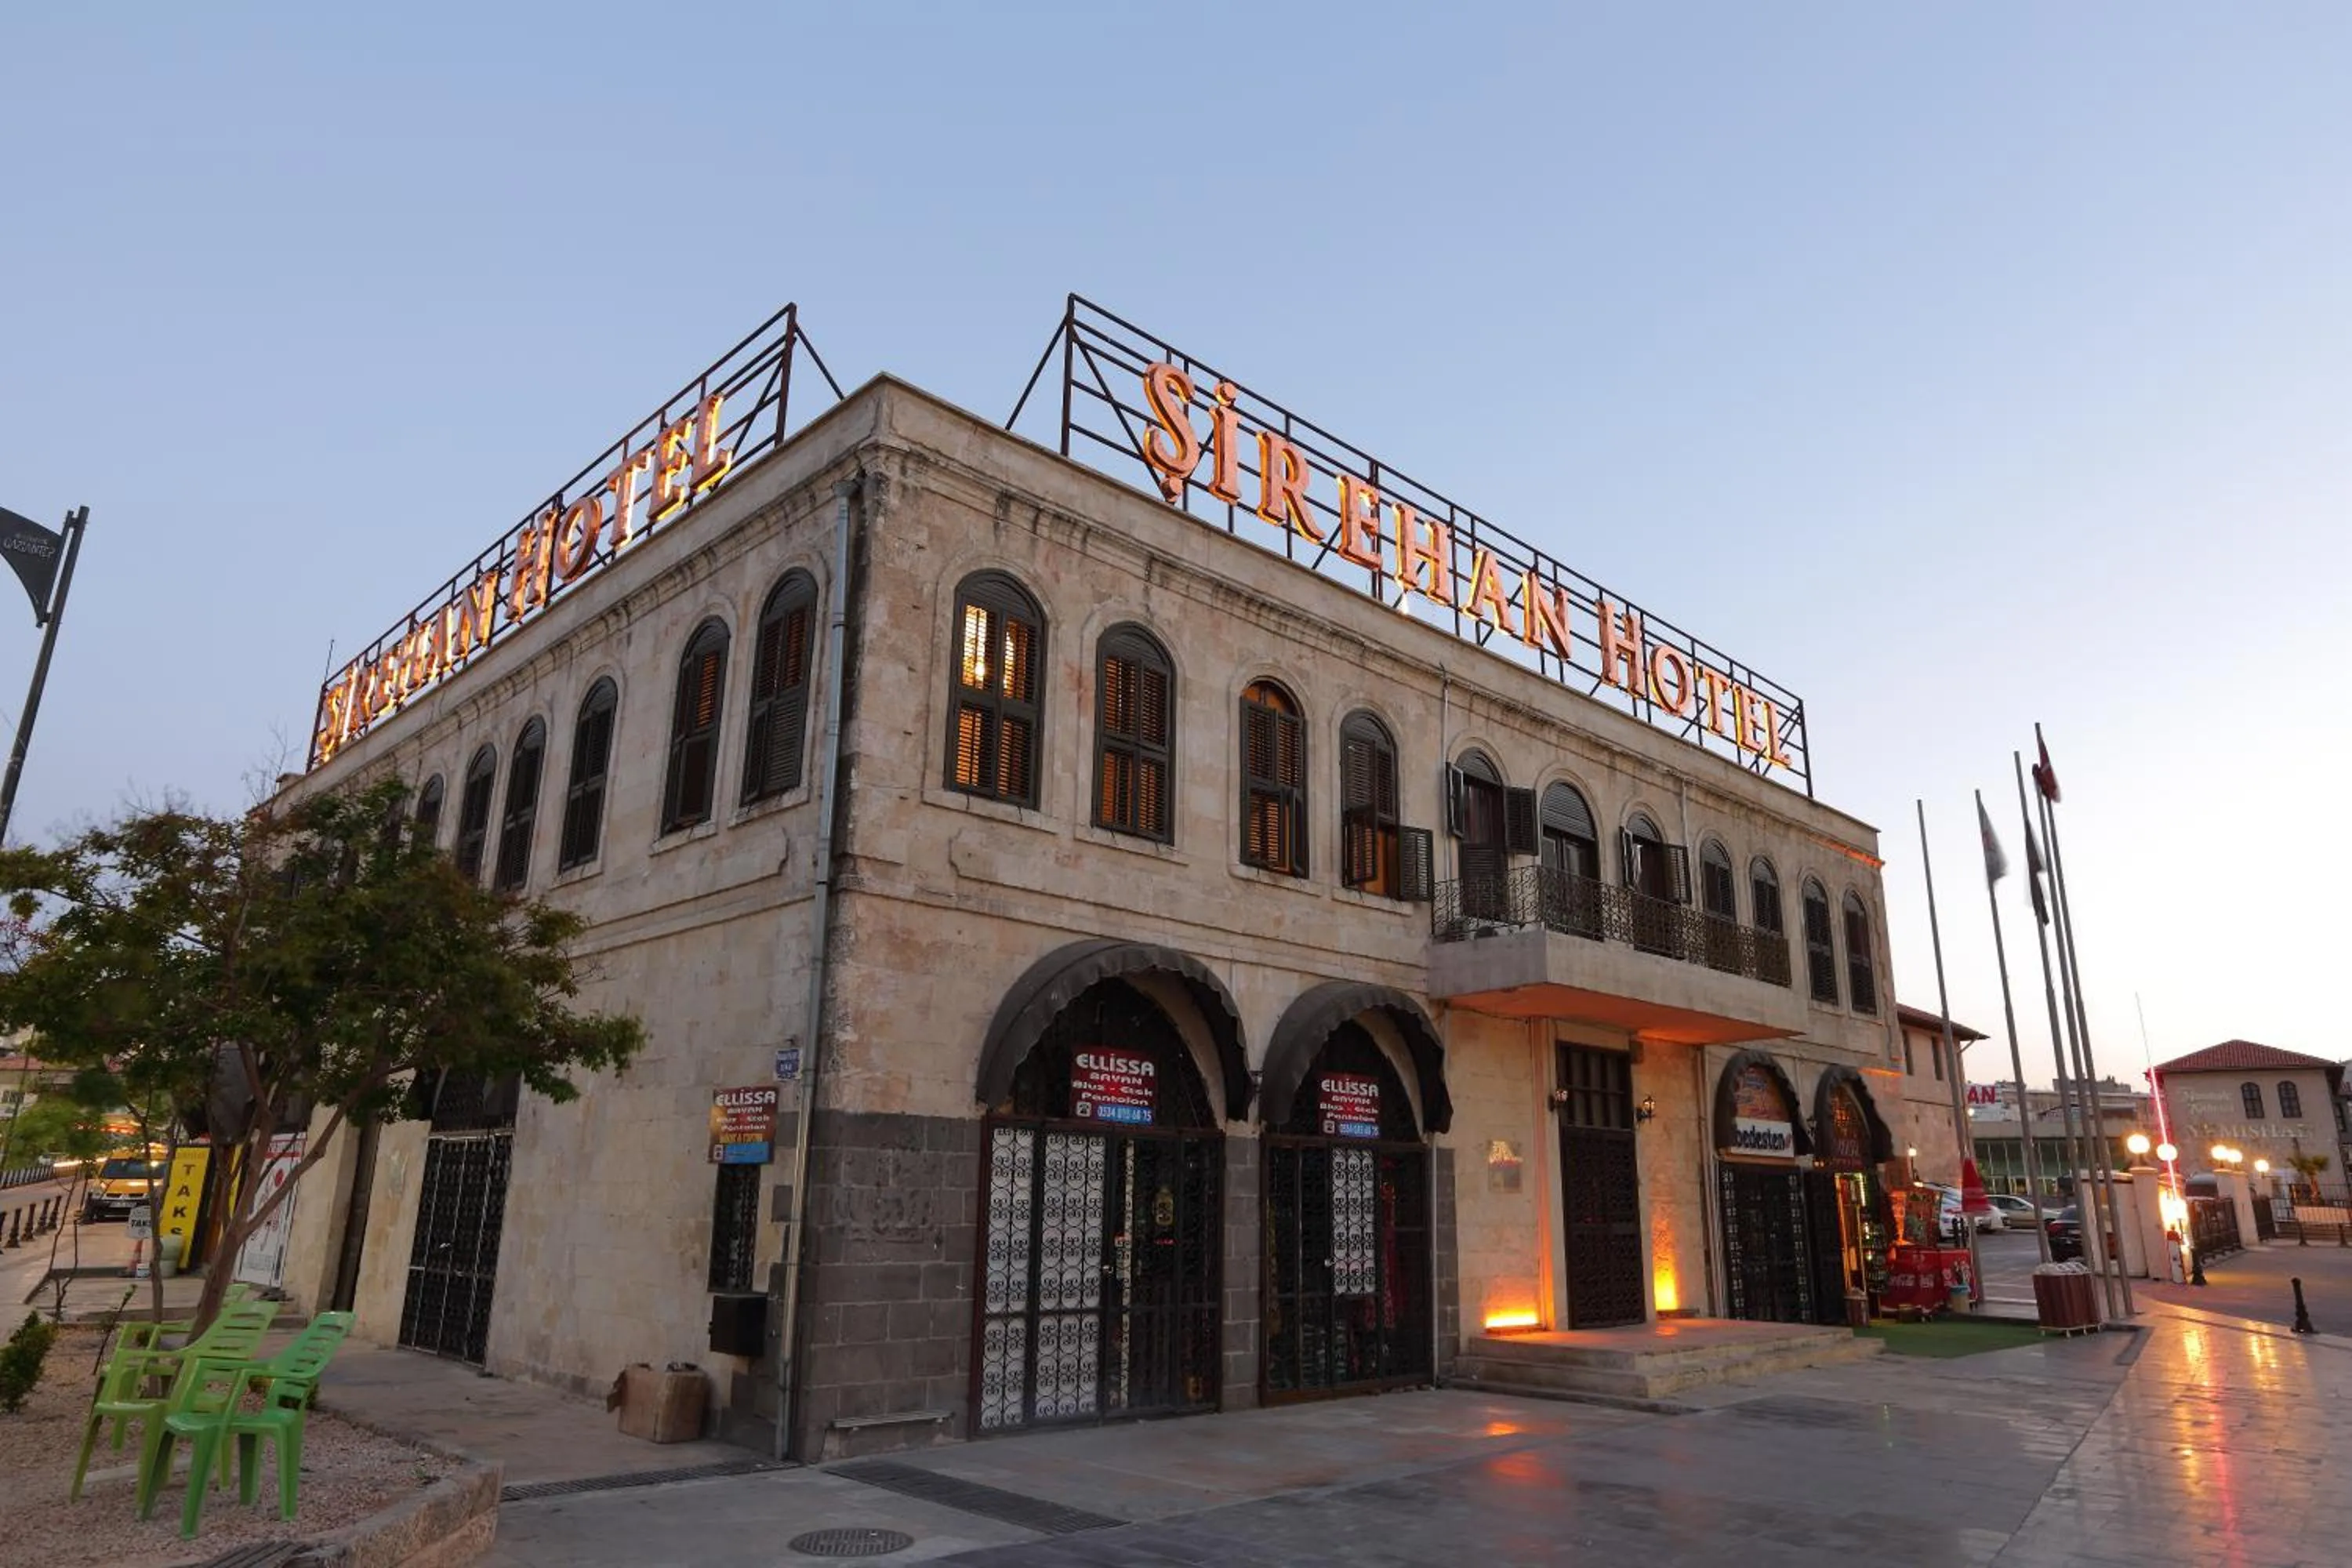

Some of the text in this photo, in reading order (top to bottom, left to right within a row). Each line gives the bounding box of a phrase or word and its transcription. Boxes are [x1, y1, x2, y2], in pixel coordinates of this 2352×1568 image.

[504, 392, 733, 623] HOTEL
[1142, 361, 1793, 768] ŞİREHAN HOTEL
[1076, 1053, 1155, 1076] ELLİSSA
[1090, 1072, 1143, 1085] BAYAN
[1321, 1078, 1379, 1098] ELLİSSA
[714, 1089, 776, 1107] ELLİSSA
